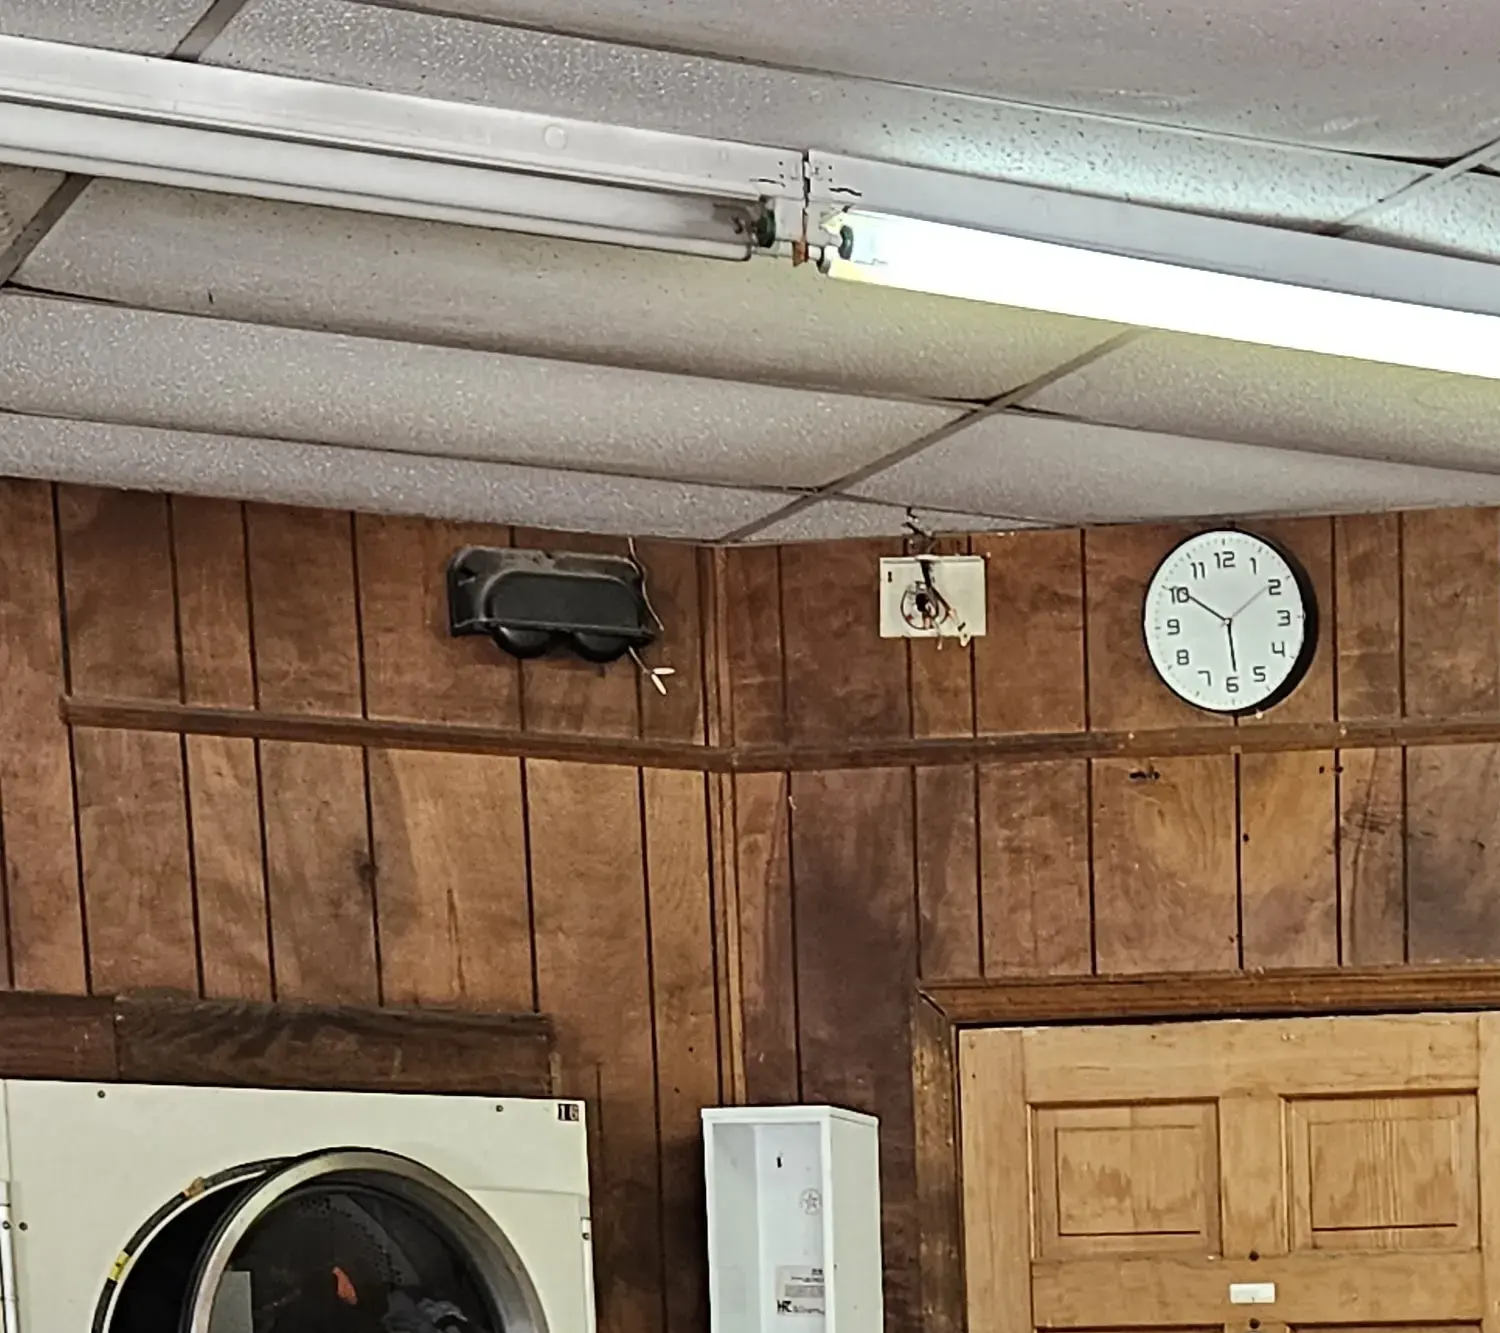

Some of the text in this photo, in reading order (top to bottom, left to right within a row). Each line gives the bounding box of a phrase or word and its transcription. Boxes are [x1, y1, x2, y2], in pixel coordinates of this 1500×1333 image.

[1214, 551, 1235, 568] 12
[1250, 557, 1257, 574] 1
[1190, 562, 1206, 580] 11
[1169, 587, 1190, 604] 10
[1268, 579, 1281, 595] 2
[1277, 610, 1291, 626] 3
[1167, 619, 1180, 635] 9
[1176, 649, 1190, 665] 8
[1271, 641, 1286, 658] 4
[1197, 670, 1211, 687] 7
[1253, 666, 1266, 682] 5
[1226, 676, 1239, 693] 6
[560, 1104, 579, 1120] 16
